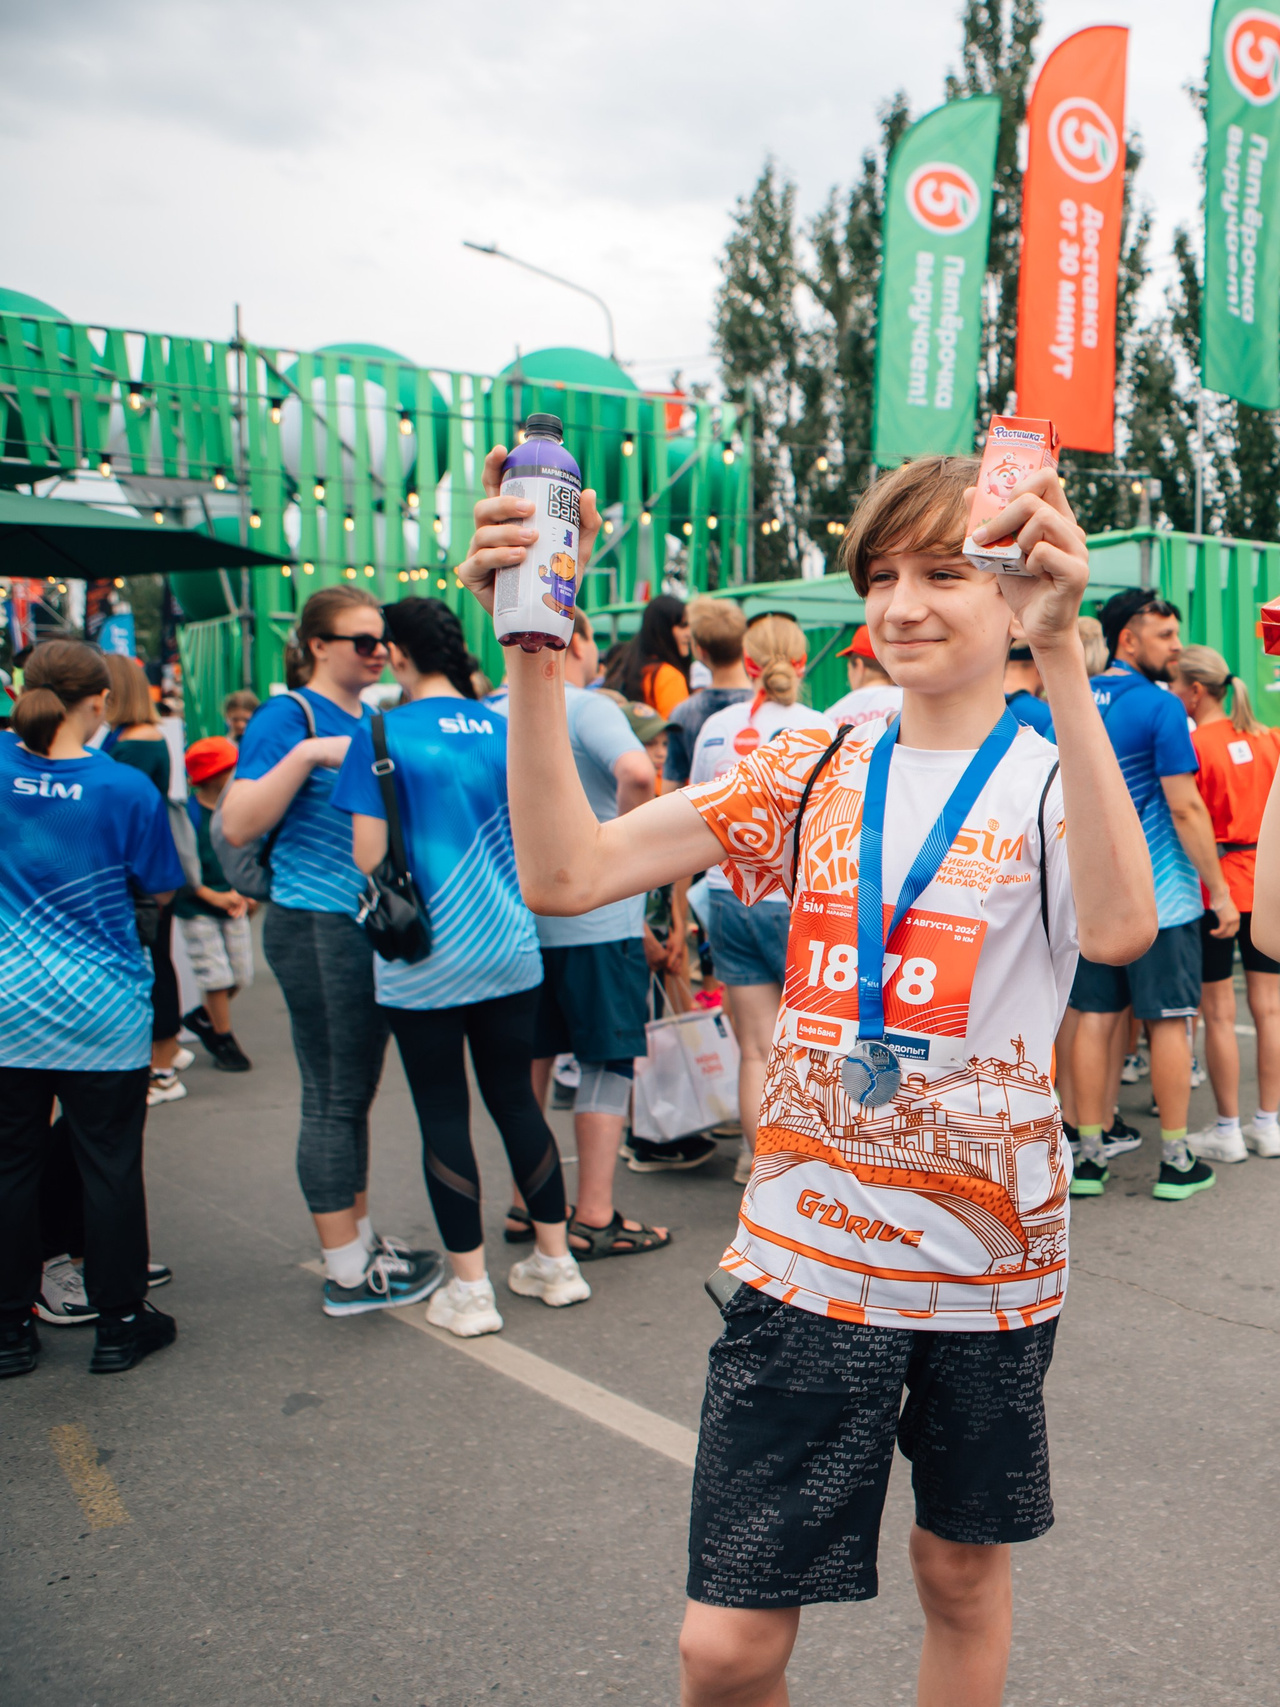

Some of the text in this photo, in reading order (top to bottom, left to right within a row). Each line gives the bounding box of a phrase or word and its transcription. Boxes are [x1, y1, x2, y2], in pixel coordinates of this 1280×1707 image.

[1238, 133, 1269, 324] Пятёрочка
[1080, 203, 1105, 348] Доставка
[1048, 199, 1080, 380] от 30 минут
[907, 251, 936, 407] выручает!
[934, 255, 966, 410] Пятёрочка
[994, 426, 1041, 441] Растишка
[935, 875, 990, 893] МАРАФОН
[905, 917, 978, 936] 3 АВГУСТА 2024
[817, 1027, 837, 1039] Банк
[888, 1042, 927, 1056] едопыт
[852, 1334, 871, 1342] FILA
[874, 1334, 893, 1342] FILA
[832, 1342, 851, 1350] FILA
[749, 1353, 767, 1361] FILA
[875, 1350, 893, 1358] FILA
[1019, 1360, 1035, 1369] FILA
[740, 1369, 755, 1378] FILA
[1016, 1367, 1033, 1376] FILA
[719, 1379, 731, 1388] FILA
[742, 1377, 757, 1385] FILA
[862, 1376, 880, 1384] FILA
[733, 1381, 747, 1390] FILA
[1020, 1380, 1036, 1390] FILA
[1018, 1390, 1035, 1399] FILA
[736, 1399, 754, 1407] FILA
[1017, 1404, 1034, 1413] FILA
[851, 1416, 869, 1424] FILA
[834, 1452, 852, 1460] FILA
[827, 1461, 845, 1469] FILA
[1025, 1469, 1041, 1479] FILA
[806, 1479, 825, 1487] FILA
[827, 1477, 845, 1485] FILA
[799, 1488, 818, 1496] FILA
[822, 1486, 841, 1494] FILA
[819, 1495, 837, 1503] FILA
[1018, 1496, 1036, 1505] FILA
[747, 1516, 766, 1524] FILA
[731, 1525, 749, 1533] FILA
[751, 1524, 769, 1532] FILA
[1031, 1523, 1047, 1533] FILA
[704, 1537, 719, 1547] FILA
[727, 1534, 745, 1542] FILA
[721, 1542, 738, 1550] FILA
[741, 1544, 759, 1552] FILA
[828, 1542, 846, 1550] FILA
[717, 1549, 734, 1557] FILA
[736, 1552, 754, 1560] FILA
[701, 1553, 717, 1563] FILA
[847, 1561, 864, 1571] FILA
[711, 1574, 728, 1582] FILA
[802, 1571, 821, 1579] FILA
[702, 1580, 717, 1589] FILA
[731, 1577, 749, 1585] FILA
[707, 1589, 723, 1597] FILA
[780, 1589, 799, 1597] FILA
[848, 1587, 866, 1595] FILA
[725, 1595, 745, 1603] FILA
